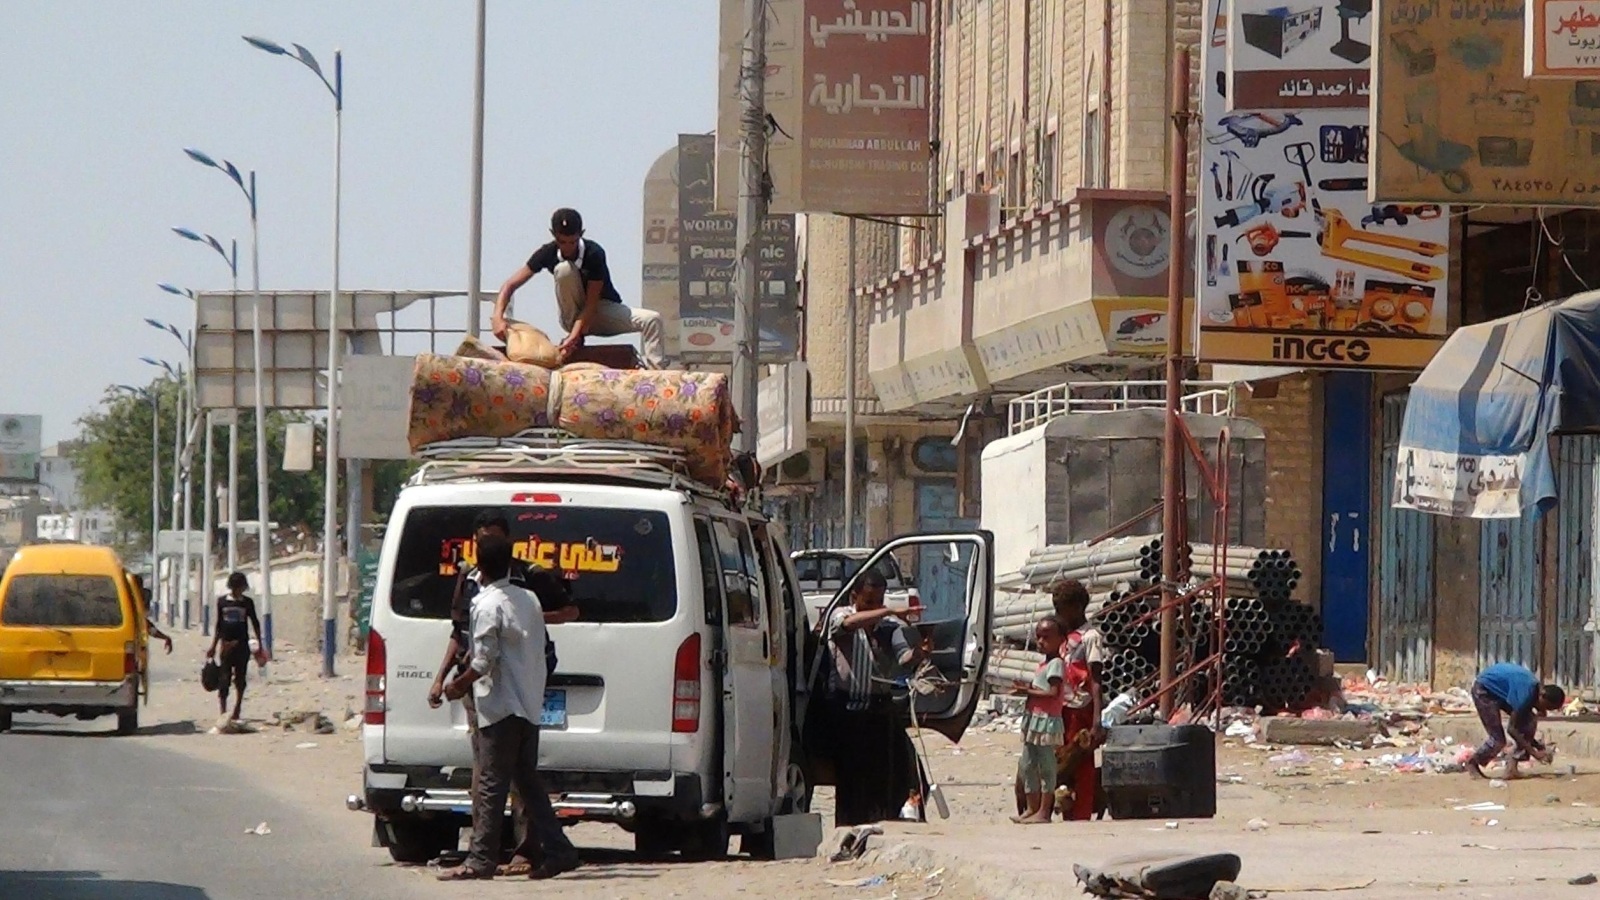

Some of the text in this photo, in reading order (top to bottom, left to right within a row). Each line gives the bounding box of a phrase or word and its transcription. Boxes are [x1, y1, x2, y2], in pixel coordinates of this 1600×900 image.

[809, 73, 925, 114] التجارية
[1279, 79, 1313, 97] قائد
[1316, 77, 1353, 96] أحمد
[683, 219, 734, 231] WORLD
[396, 671, 433, 679] HIACE
